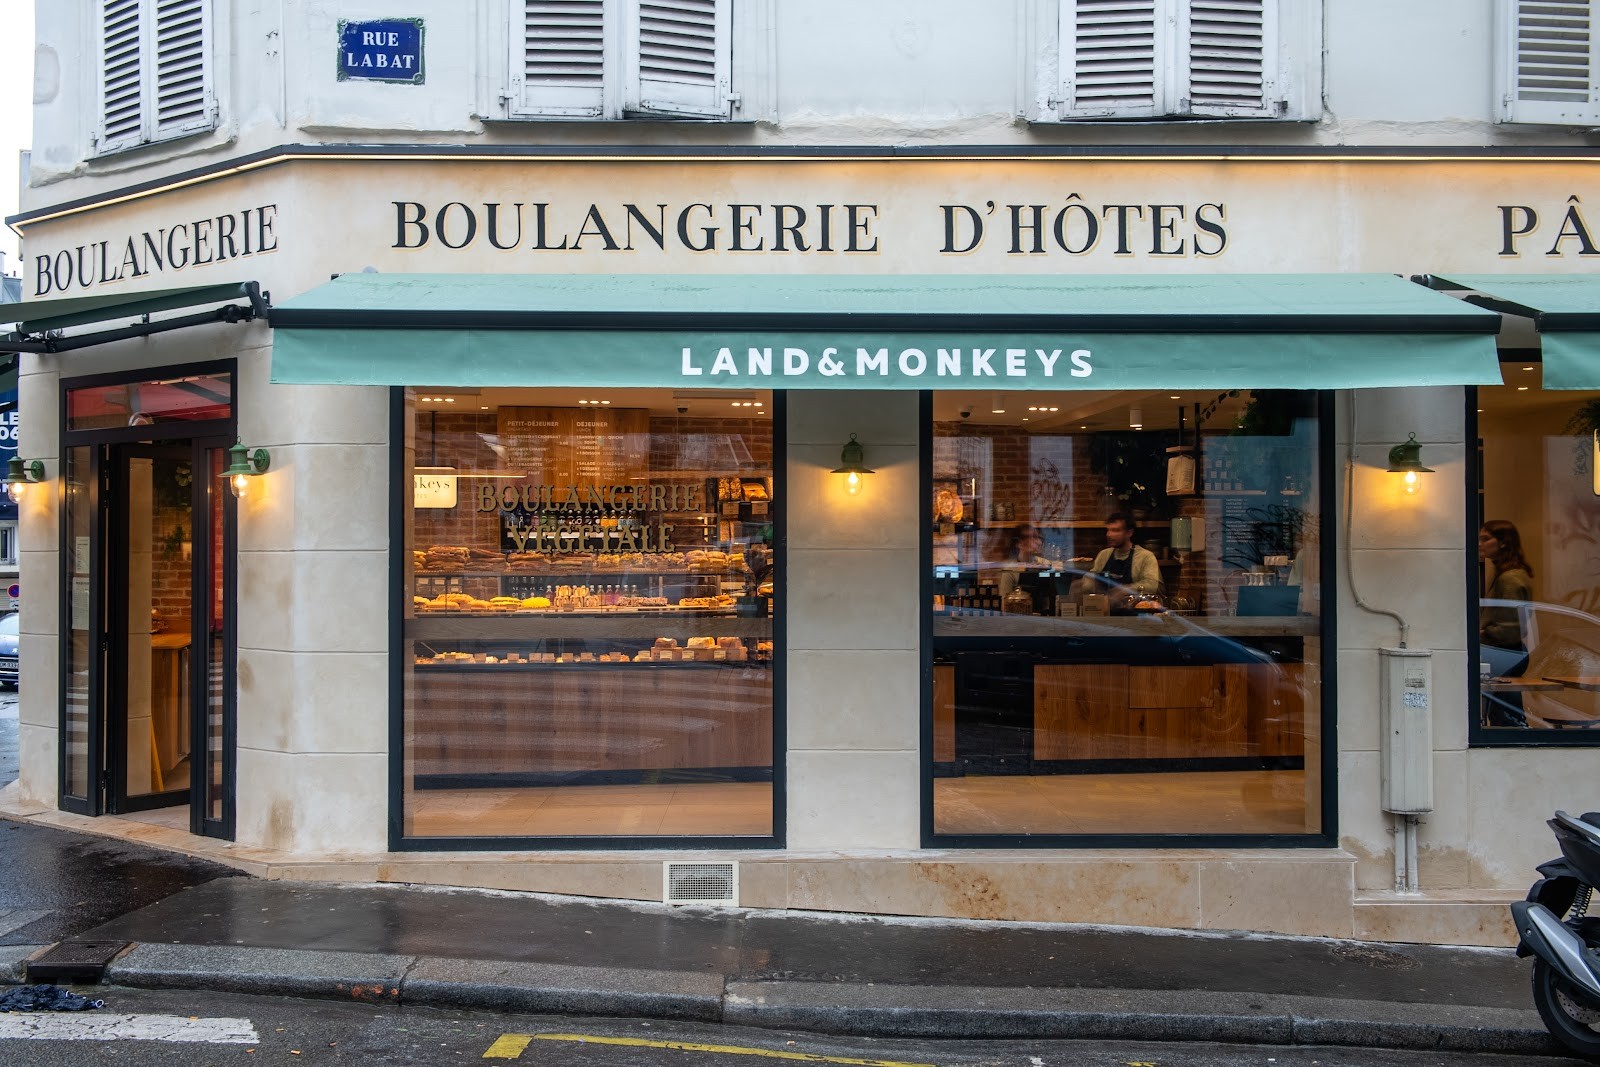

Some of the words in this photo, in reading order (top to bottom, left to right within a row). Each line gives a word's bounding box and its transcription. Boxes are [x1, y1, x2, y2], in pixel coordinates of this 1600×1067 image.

[362, 31, 399, 47] RUE
[347, 52, 415, 70] LABAT
[391, 201, 880, 252] BOULANGERIE
[939, 192, 1227, 257] D'HÔTES
[1497, 194, 1600, 256] PÂ
[35, 204, 279, 297] BOULANGERIE
[681, 347, 1094, 378] LAND&MONKEYS
[477, 483, 700, 513] BOULANGERIE
